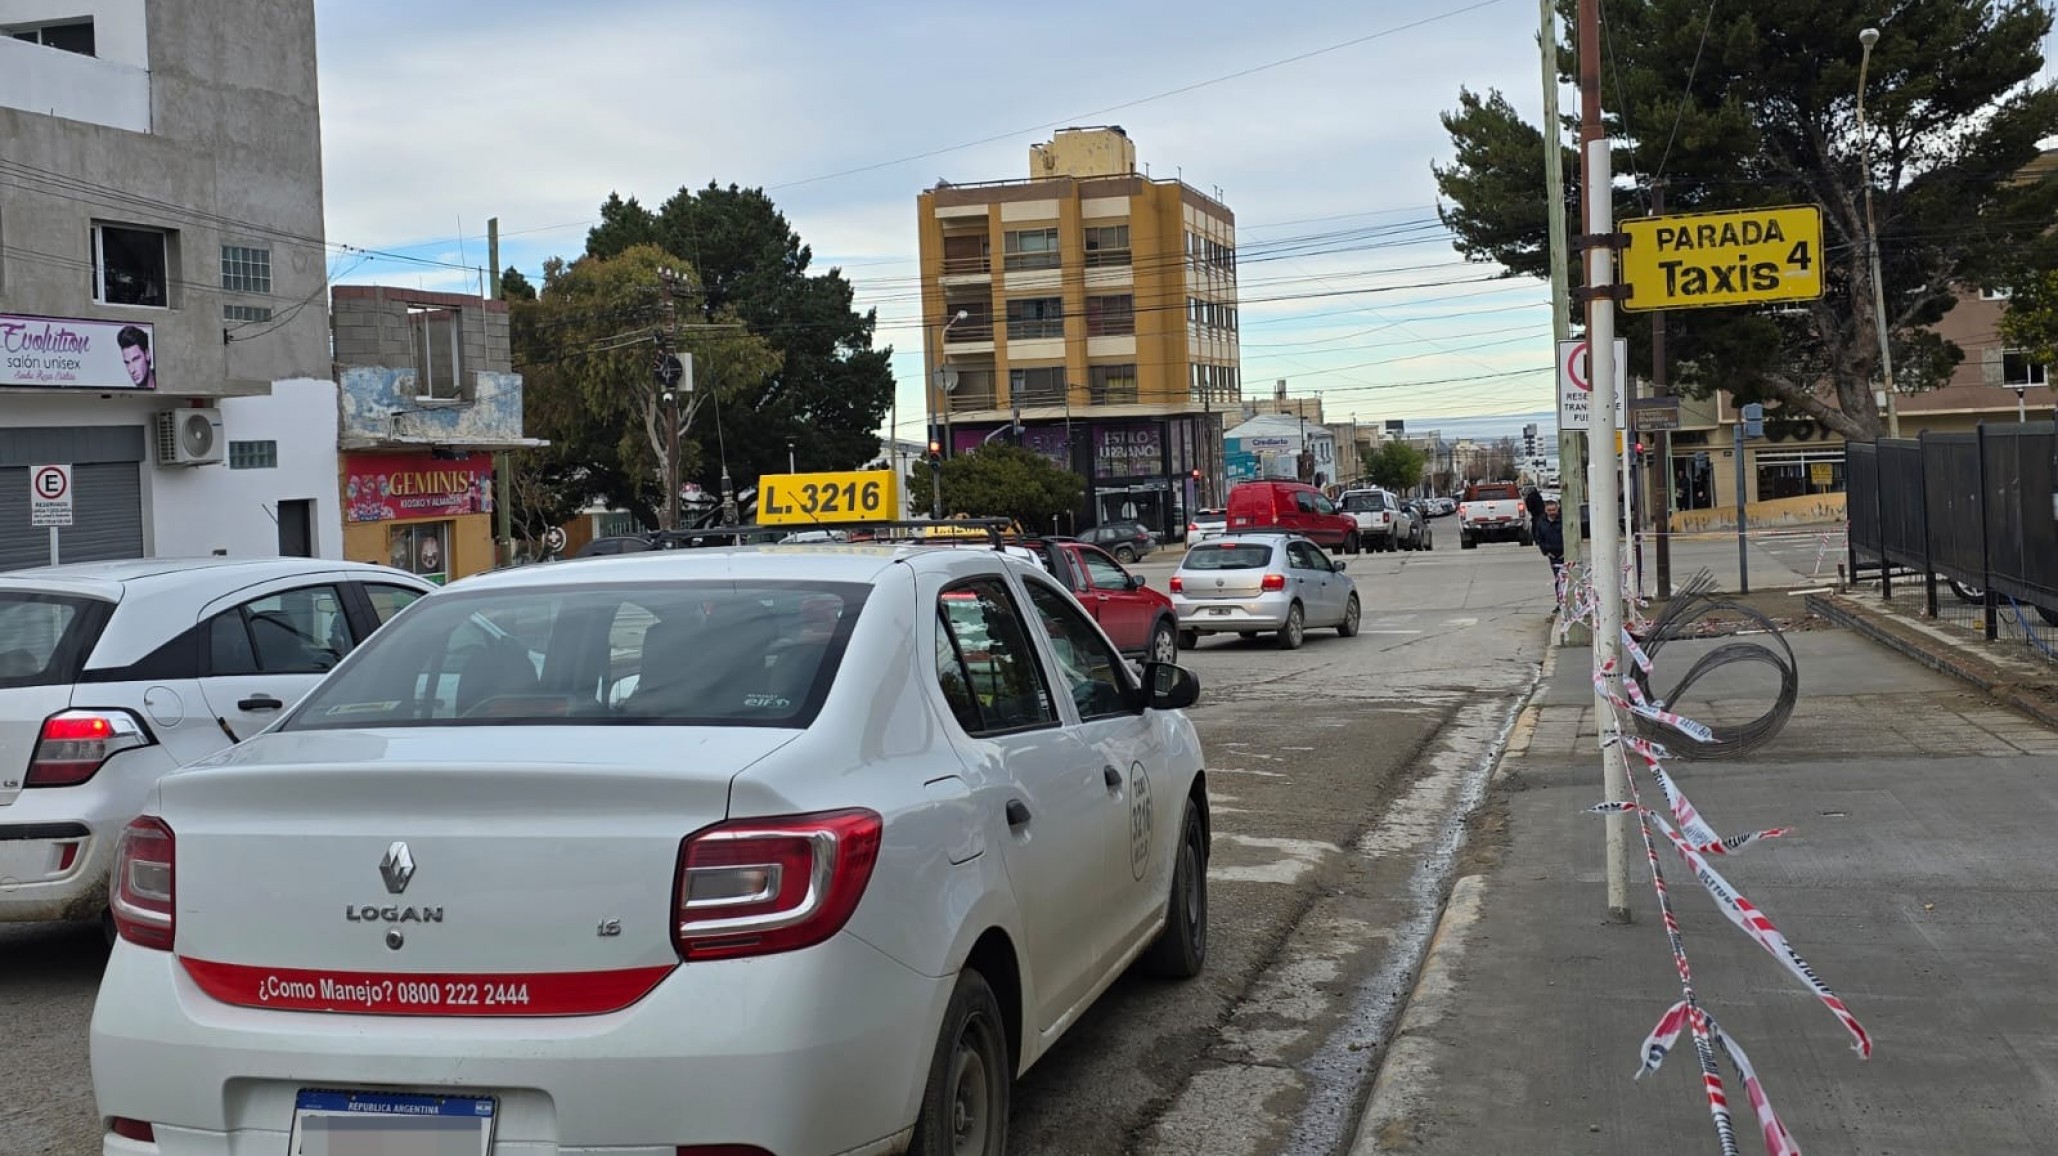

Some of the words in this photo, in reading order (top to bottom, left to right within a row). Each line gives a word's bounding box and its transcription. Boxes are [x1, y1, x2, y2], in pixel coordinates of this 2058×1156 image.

[1656, 219, 1785, 252] PARADA
[1658, 254, 1780, 297] Taxis
[1786, 240, 1812, 270] 4
[0, 323, 91, 354] Evolution
[7, 355, 41, 369] salón
[43, 356, 81, 370] unisex
[1564, 402, 1622, 411] TRANE
[1566, 392, 1619, 400] RESEO
[1100, 445, 1155, 459] URBANO
[44, 474, 59, 493] E
[389, 470, 468, 496] GEMINIS
[765, 486, 792, 515] L.
[801, 481, 881, 514] 3216
[1133, 777, 1146, 798] TAXI
[1132, 798, 1151, 840] 3216
[346, 904, 443, 923] LOGAN
[259, 976, 316, 1001] ¿Como
[319, 978, 393, 1006] Manejo?
[397, 982, 440, 1005] 0800
[445, 983, 479, 1005] 222
[483, 983, 530, 1005] 2444
[393, 1104, 439, 1115] ARGENTINA
